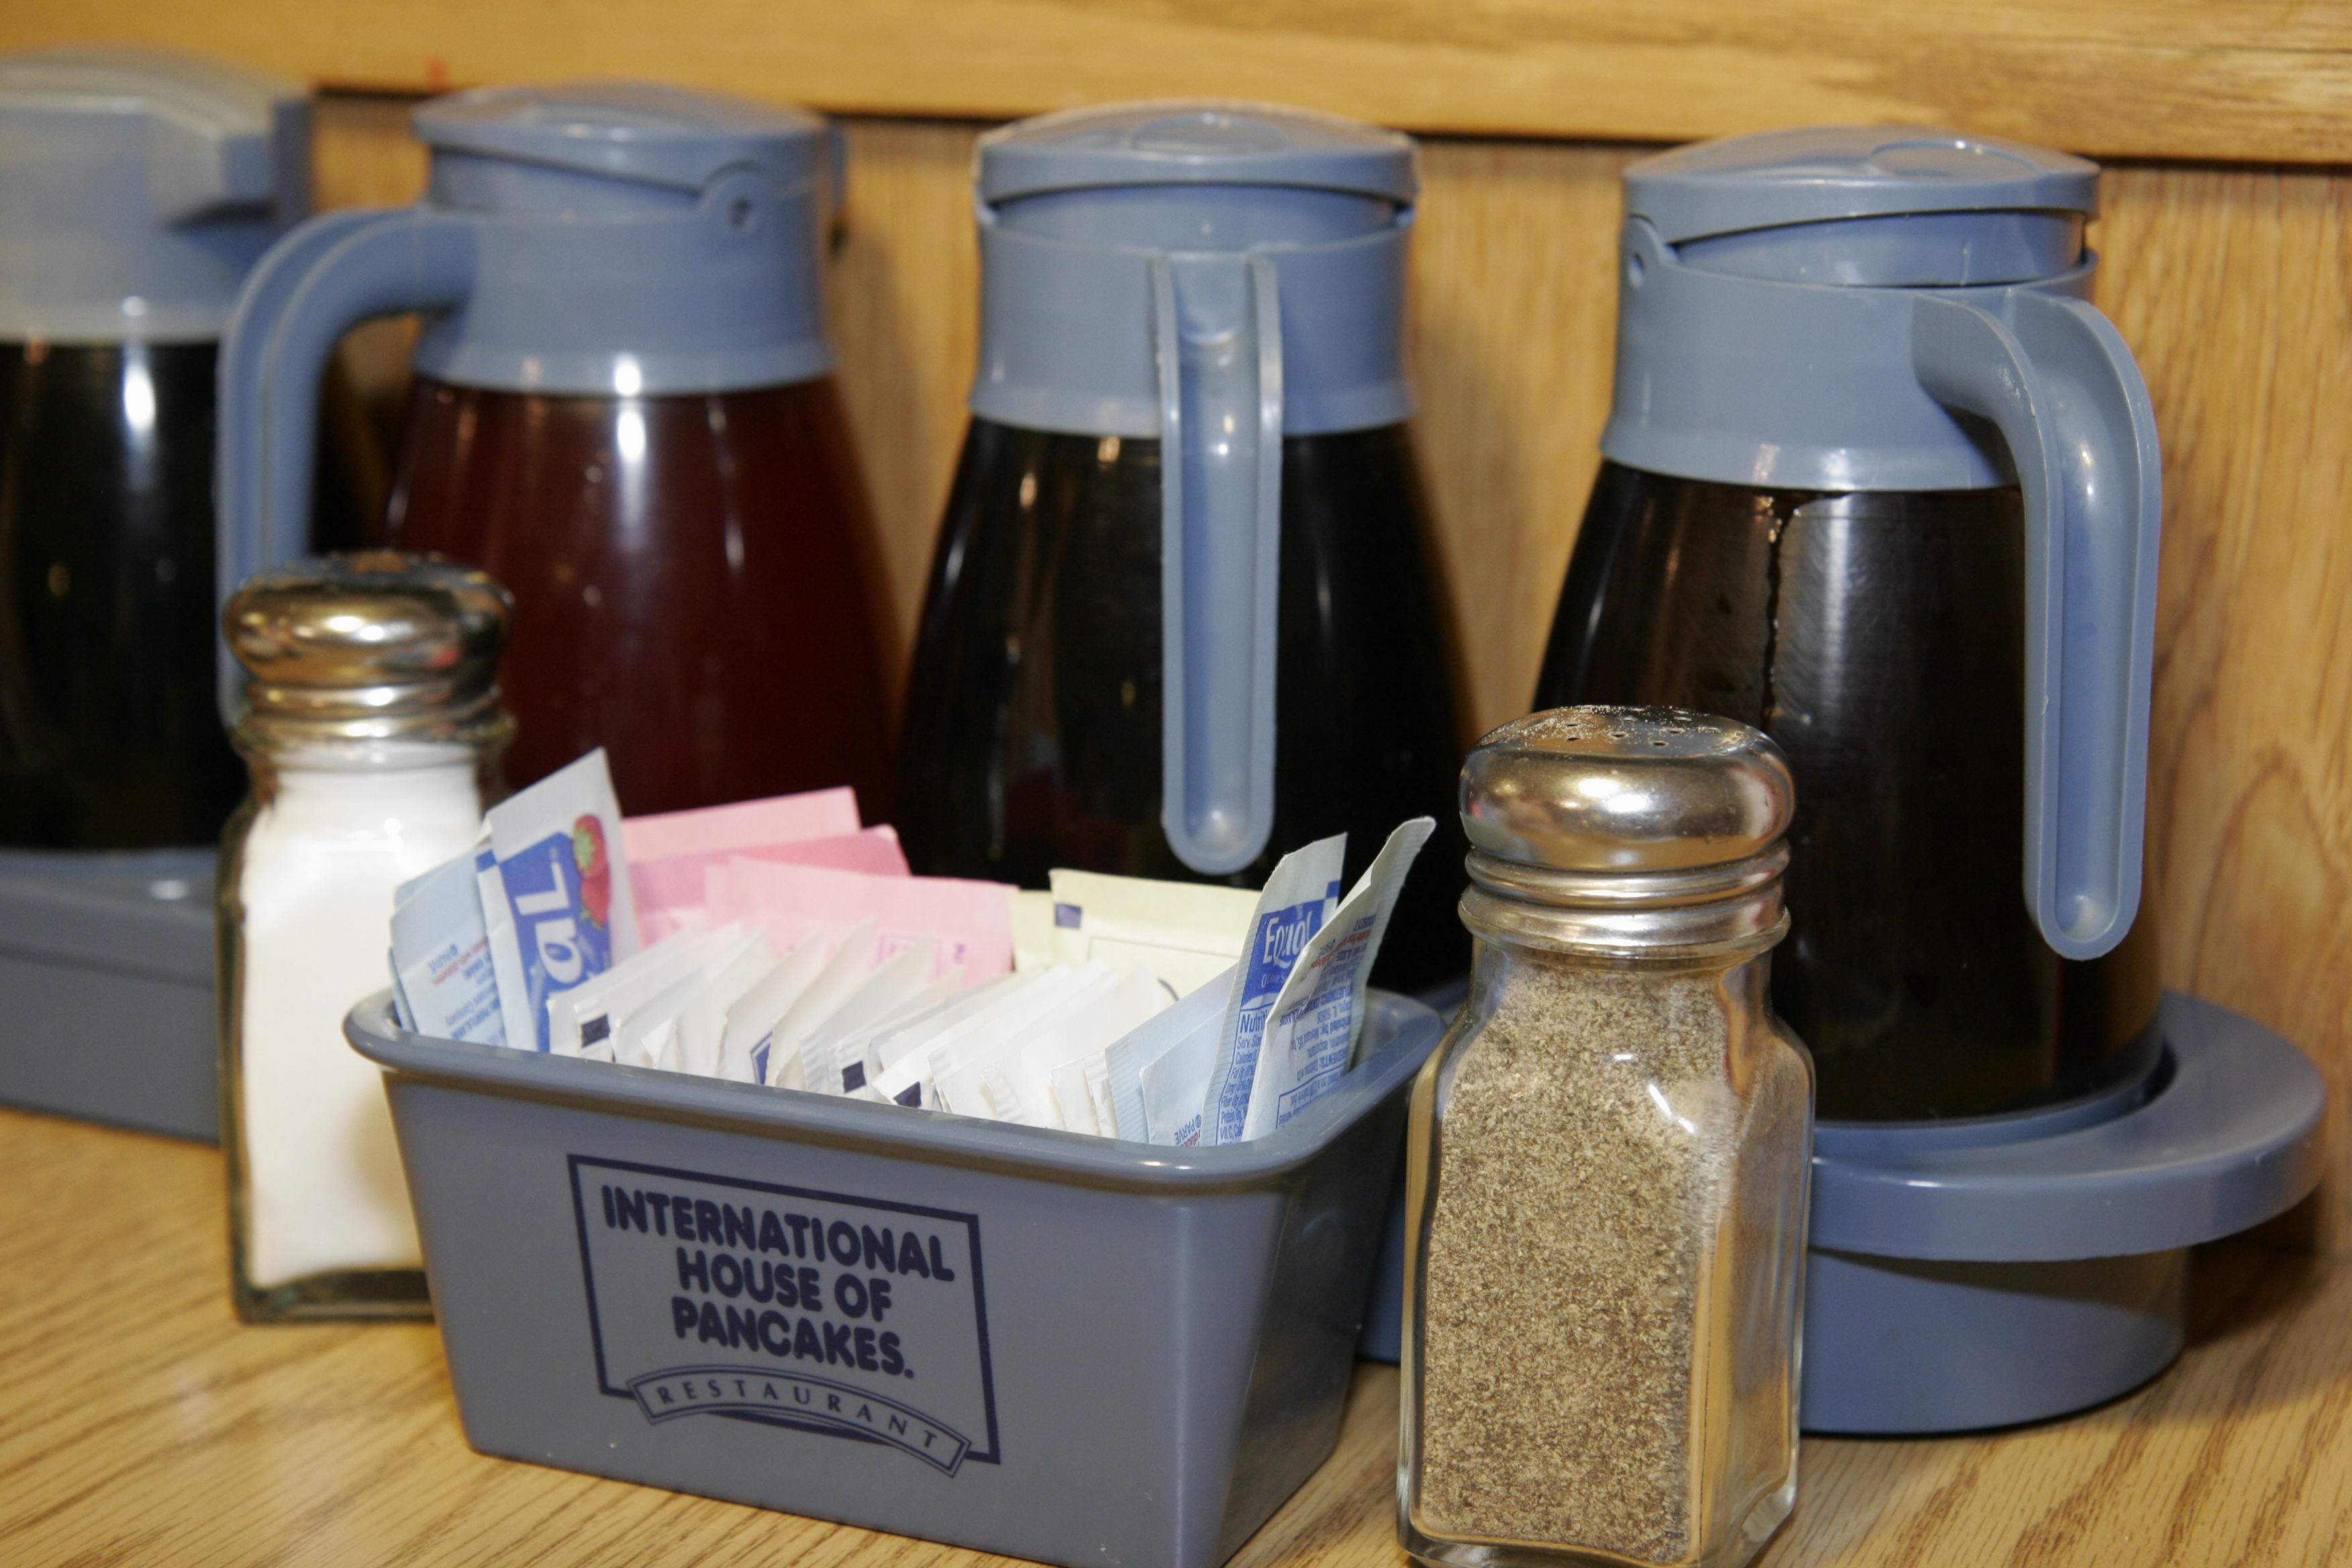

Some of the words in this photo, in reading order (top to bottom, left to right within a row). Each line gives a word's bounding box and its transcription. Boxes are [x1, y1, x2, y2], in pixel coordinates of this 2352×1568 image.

[600, 1184, 957, 1283] INTERNATIONAL
[676, 1246, 824, 1314] HOUSE
[833, 1273, 893, 1323] OF
[656, 1378, 939, 1450] RESTAURANT
